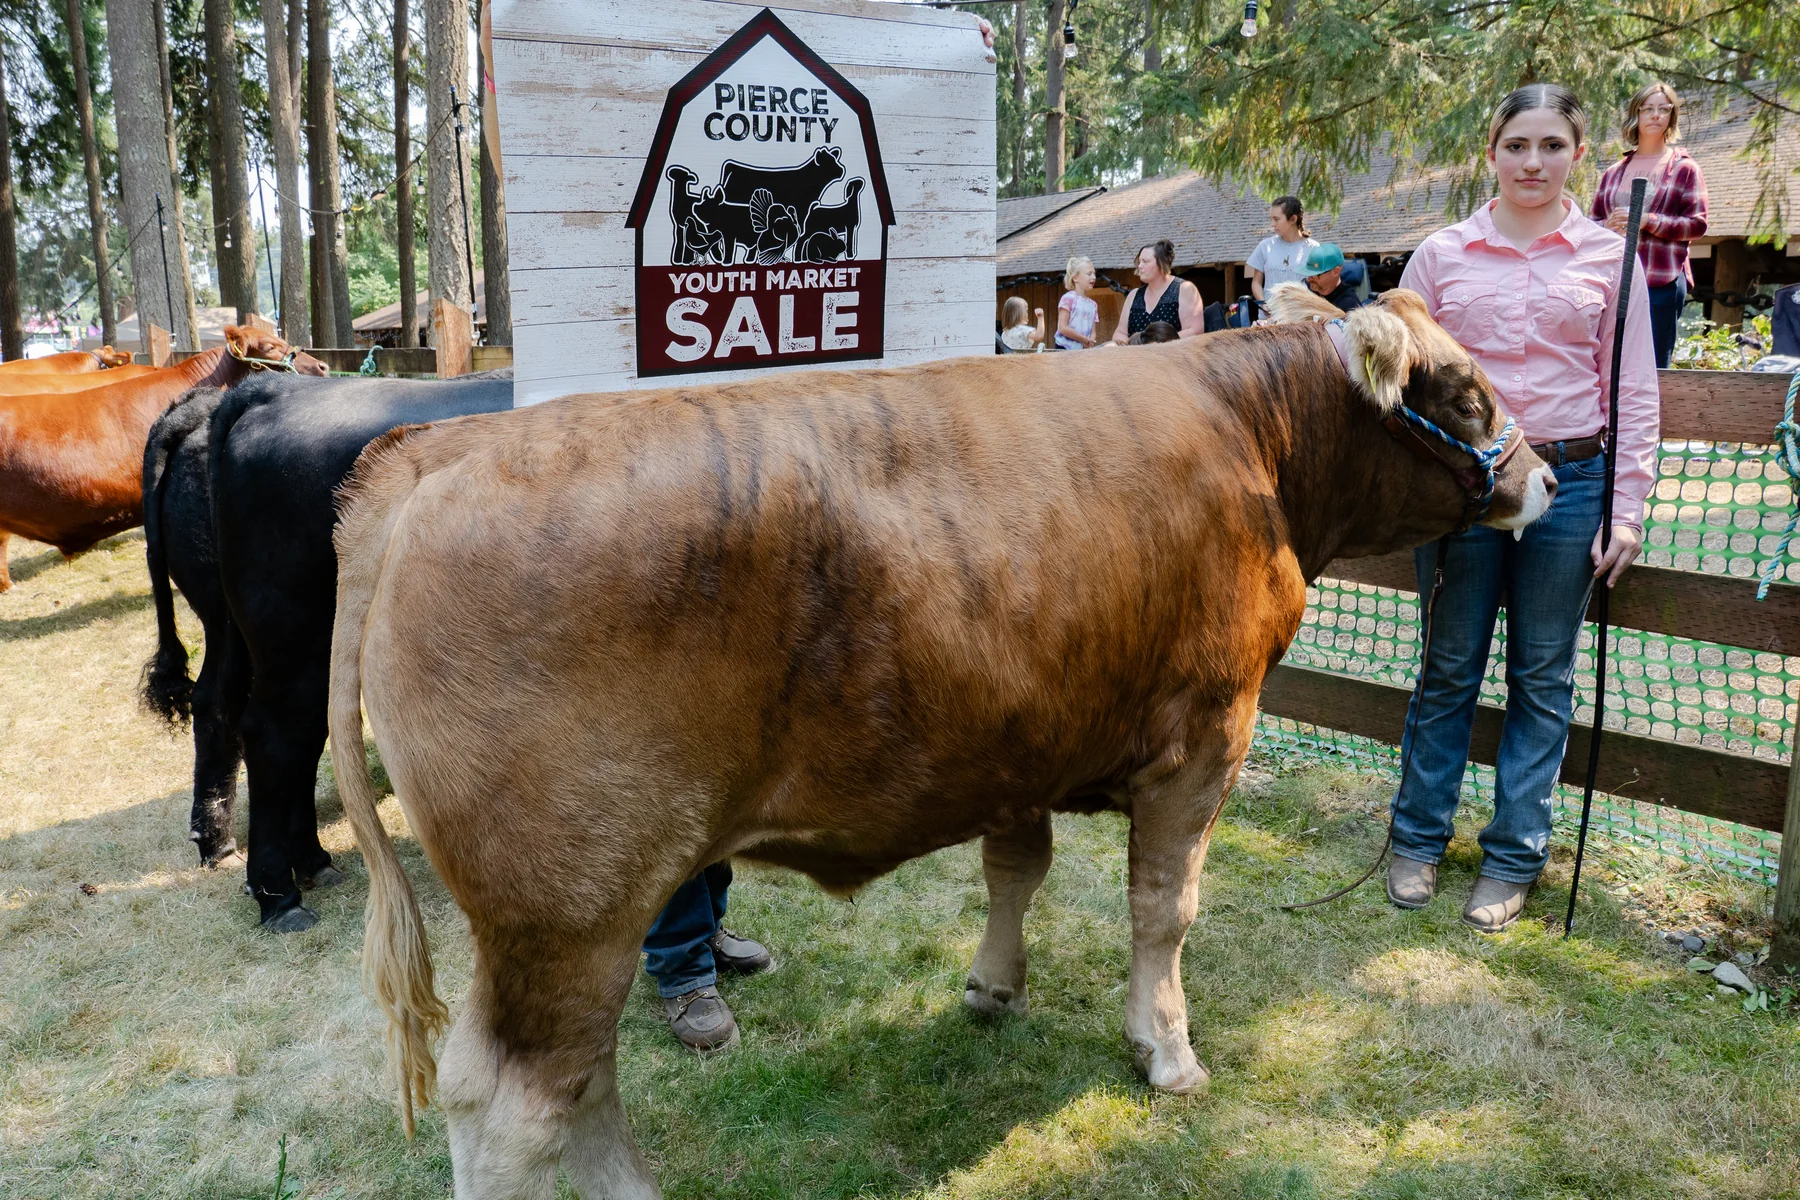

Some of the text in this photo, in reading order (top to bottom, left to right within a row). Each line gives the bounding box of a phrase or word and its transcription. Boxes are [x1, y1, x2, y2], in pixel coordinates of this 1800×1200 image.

[714, 82, 829, 115] PIERCE
[703, 112, 839, 143] COUNTY
[668, 267, 861, 294] YOUTH MARKET
[664, 291, 860, 362] SALE
